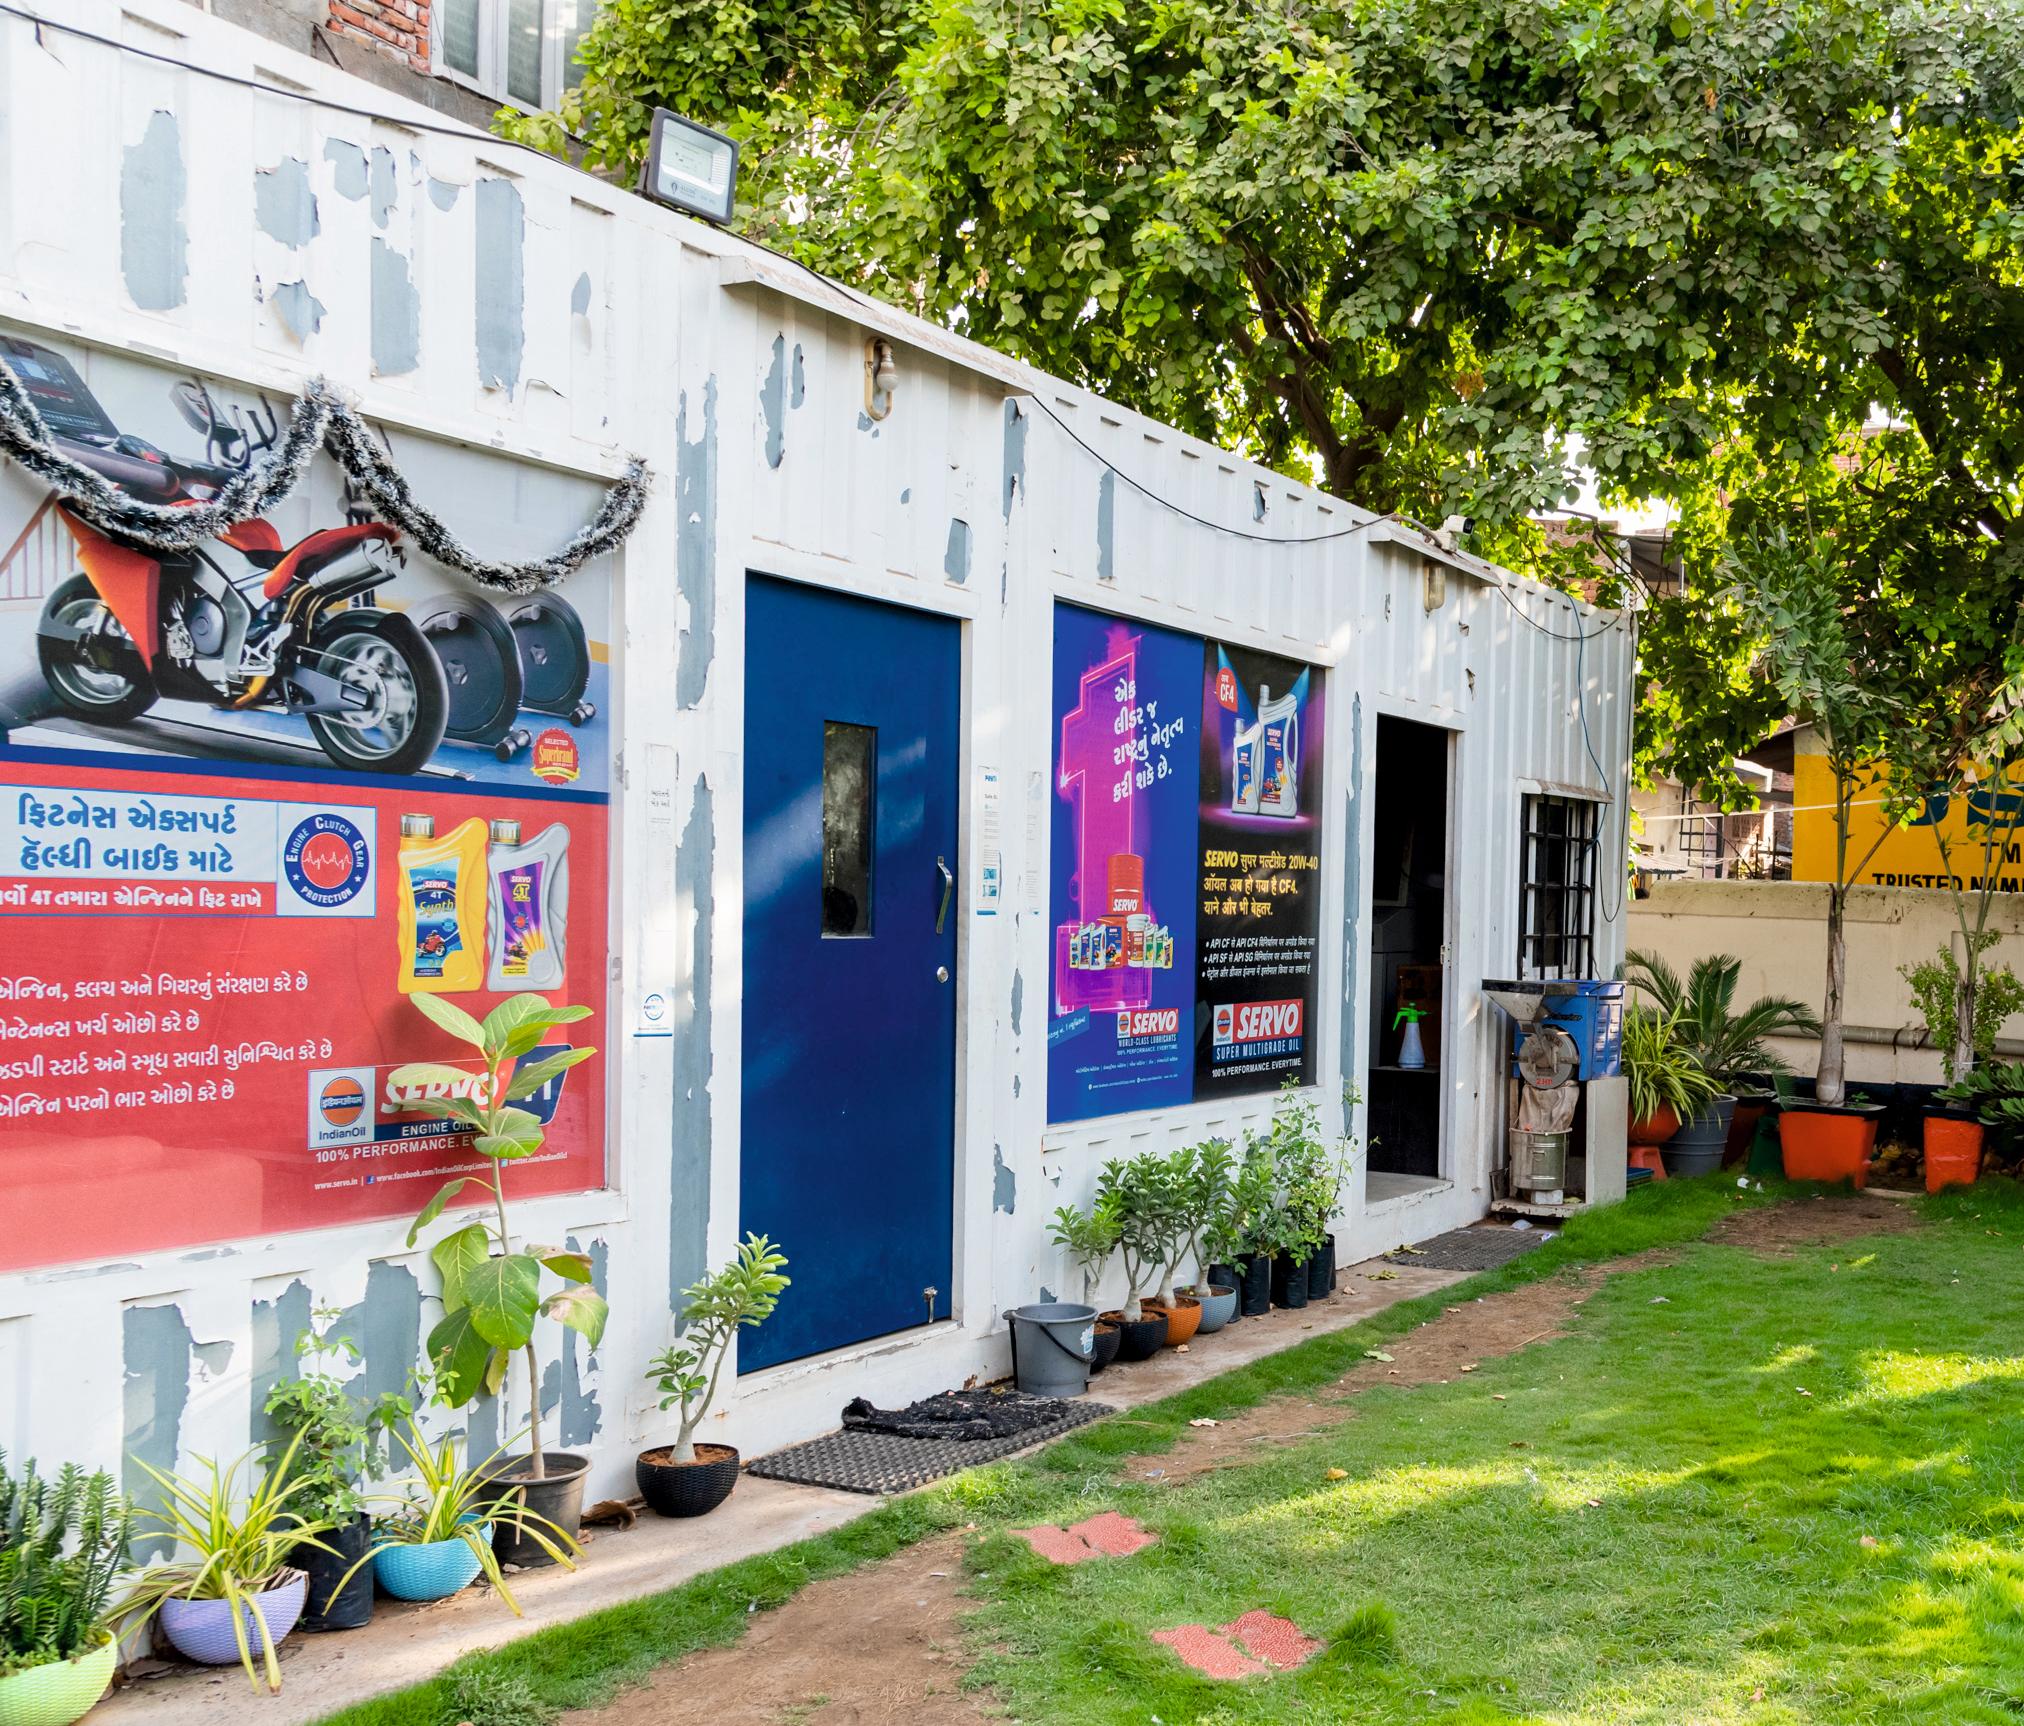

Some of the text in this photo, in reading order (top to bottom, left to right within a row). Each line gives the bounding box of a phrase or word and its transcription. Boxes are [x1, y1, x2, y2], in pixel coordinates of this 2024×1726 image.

[1114, 677, 1137, 703] એક
[1220, 683, 1235, 704] CF4
[1113, 700, 1158, 735] લીડર જ
[1150, 716, 1184, 749] નેતૃત્વ
[1112, 754, 1173, 803] કરી શકે છે.
[18, 792, 117, 829] ફિટનેસ
[285, 827, 310, 863] ENGINE
[102, 842, 180, 872] બાઈક
[188, 842, 234, 873] માટે
[1203, 850, 1319, 873] SERVO सुपर मल्टीग्रेड 20W-40
[300, 885, 353, 904] PROTECTION
[430, 891, 443, 899] 4T
[512, 883, 531, 898] 4T
[1203, 872, 1228, 892] ऑयल
[1229, 878, 1243, 893] अब
[1244, 874, 1254, 896] हो
[1255, 879, 1270, 894] गया
[1271, 875, 1278, 896] है
[30, 890, 52, 906] 4T
[54, 891, 108, 906] તમારા
[113, 886, 193, 907] એન્જિનને
[200, 887, 226, 908] ફિટ
[230, 888, 262, 908] રાખે
[419, 898, 454, 917] Synth
[1112, 898, 1138, 912] SERVO
[1203, 896, 1220, 916] याने
[1221, 896, 1238, 916] और
[1239, 896, 1249, 916] भी
[1210, 938, 1221, 949] API
[1221, 938, 1230, 949] CF
[1236, 938, 1247, 948] API
[1208, 953, 1219, 964] API
[1219, 953, 1228, 963] SF
[1234, 952, 1245, 963] API
[1245, 952, 1253, 962] SG
[120, 974, 152, 996] અને
[158, 971, 213, 1000] ગિયરનું
[216, 971, 269, 993] સંરક્ષણ
[273, 970, 292, 992] કરે
[295, 970, 309, 991] છે
[75, 1012, 109, 1036] ખર્ચ
[112, 1011, 156, 1034] ઓછો
[161, 1009, 182, 1033] કરે
[185, 1008, 200, 1032] છે
[1132, 1010, 1177, 1035] SERVO
[1237, 1002, 1299, 1040] SERVO
[49, 1051, 89, 1076] સ્ટાર્ટ
[93, 1049, 126, 1072] અને
[173, 1044, 219, 1067] સવારી
[298, 1039, 316, 1061] કરે
[320, 1038, 333, 1059] છે
[1216, 1038, 1300, 1060] SUPER MULTIGRADE OIL
[1212, 1068, 1226, 1078] 100%
[66, 1087, 109, 1112] પરનો
[115, 1091, 146, 1108] ભાર
[150, 1081, 192, 1105] ઓછો
[197, 1079, 217, 1102] કરે
[220, 1078, 235, 1100] છે
[319, 1126, 366, 1141] IndianOil
[402, 1122, 448, 1137] ENGINE
[315, 1149, 349, 1163] 100%
[353, 1136, 460, 1159] PERFORMANCE.
